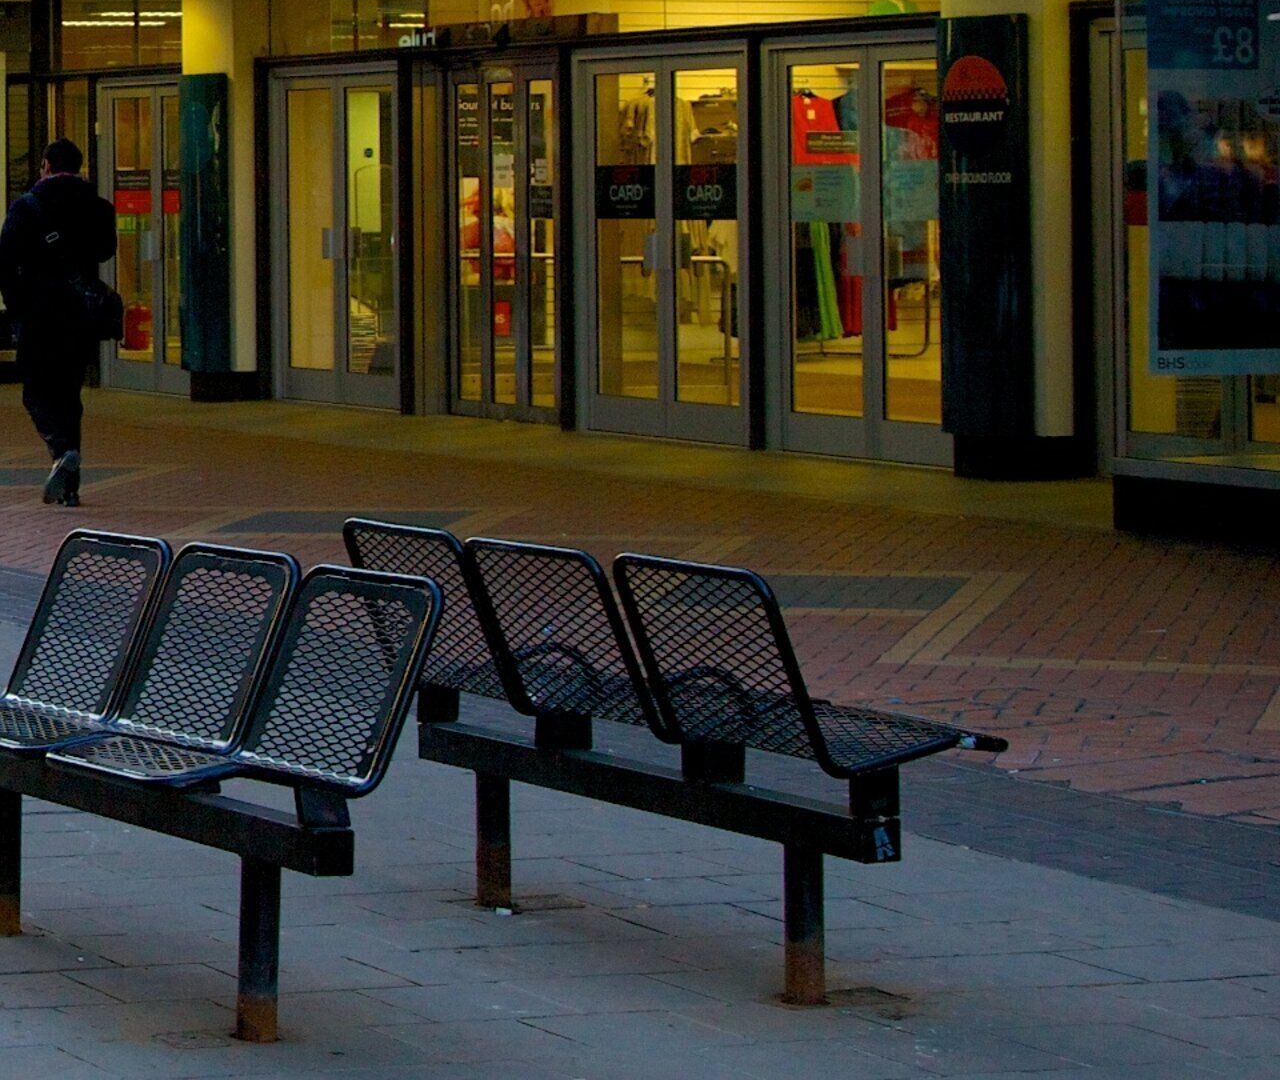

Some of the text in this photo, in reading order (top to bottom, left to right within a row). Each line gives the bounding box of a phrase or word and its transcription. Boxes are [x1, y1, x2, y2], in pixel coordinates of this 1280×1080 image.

[1211, 25, 1254, 65] £8
[944, 111, 1005, 124] RESTAURANT
[609, 184, 643, 201] CARD
[686, 184, 722, 202] CARD
